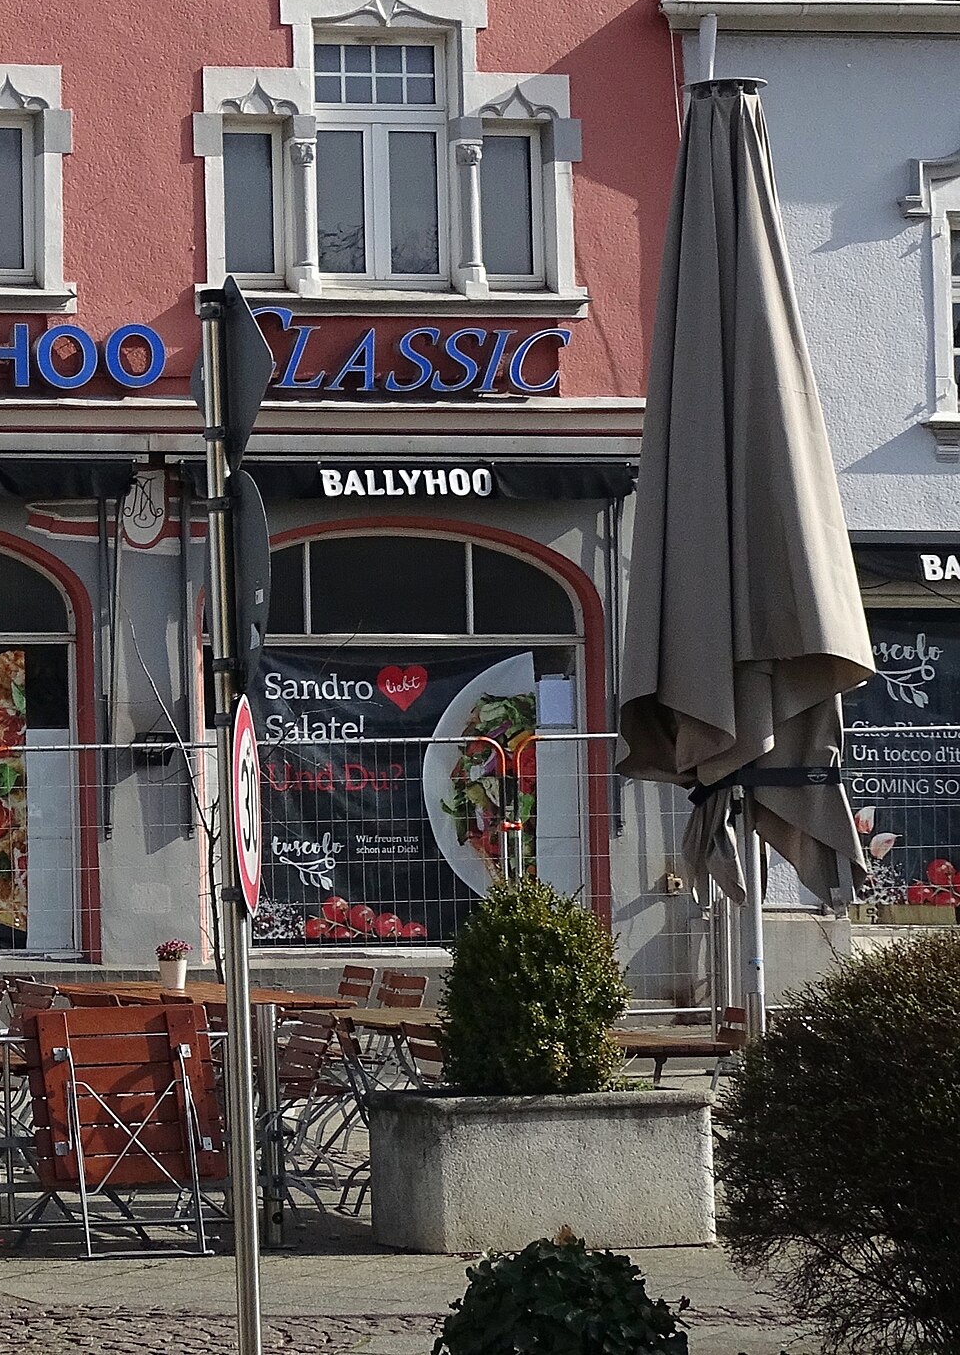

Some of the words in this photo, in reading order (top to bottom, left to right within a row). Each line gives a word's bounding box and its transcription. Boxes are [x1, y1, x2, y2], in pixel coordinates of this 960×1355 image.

[320, 469, 493, 497] BALLYHOO
[920, 554, 960, 581] BA
[264, 672, 374, 700] Sandro
[385, 675, 421, 694] liebt
[265, 714, 365, 742] Salate!
[851, 744, 879, 761] Un
[883, 746, 932, 762] tocco
[266, 761, 336, 792] Und
[343, 762, 404, 792] Du?
[851, 777, 930, 794] COMING
[934, 779, 960, 795] SO
[241, 758, 258, 853] 30
[271, 832, 345, 856] tuscolo
[355, 835, 373, 843] Wir
[374, 834, 402, 843] freuen
[403, 835, 419, 843] uns
[355, 845, 381, 854] schon
[381, 845, 396, 854] auf
[397, 845, 419, 854] Dich!
